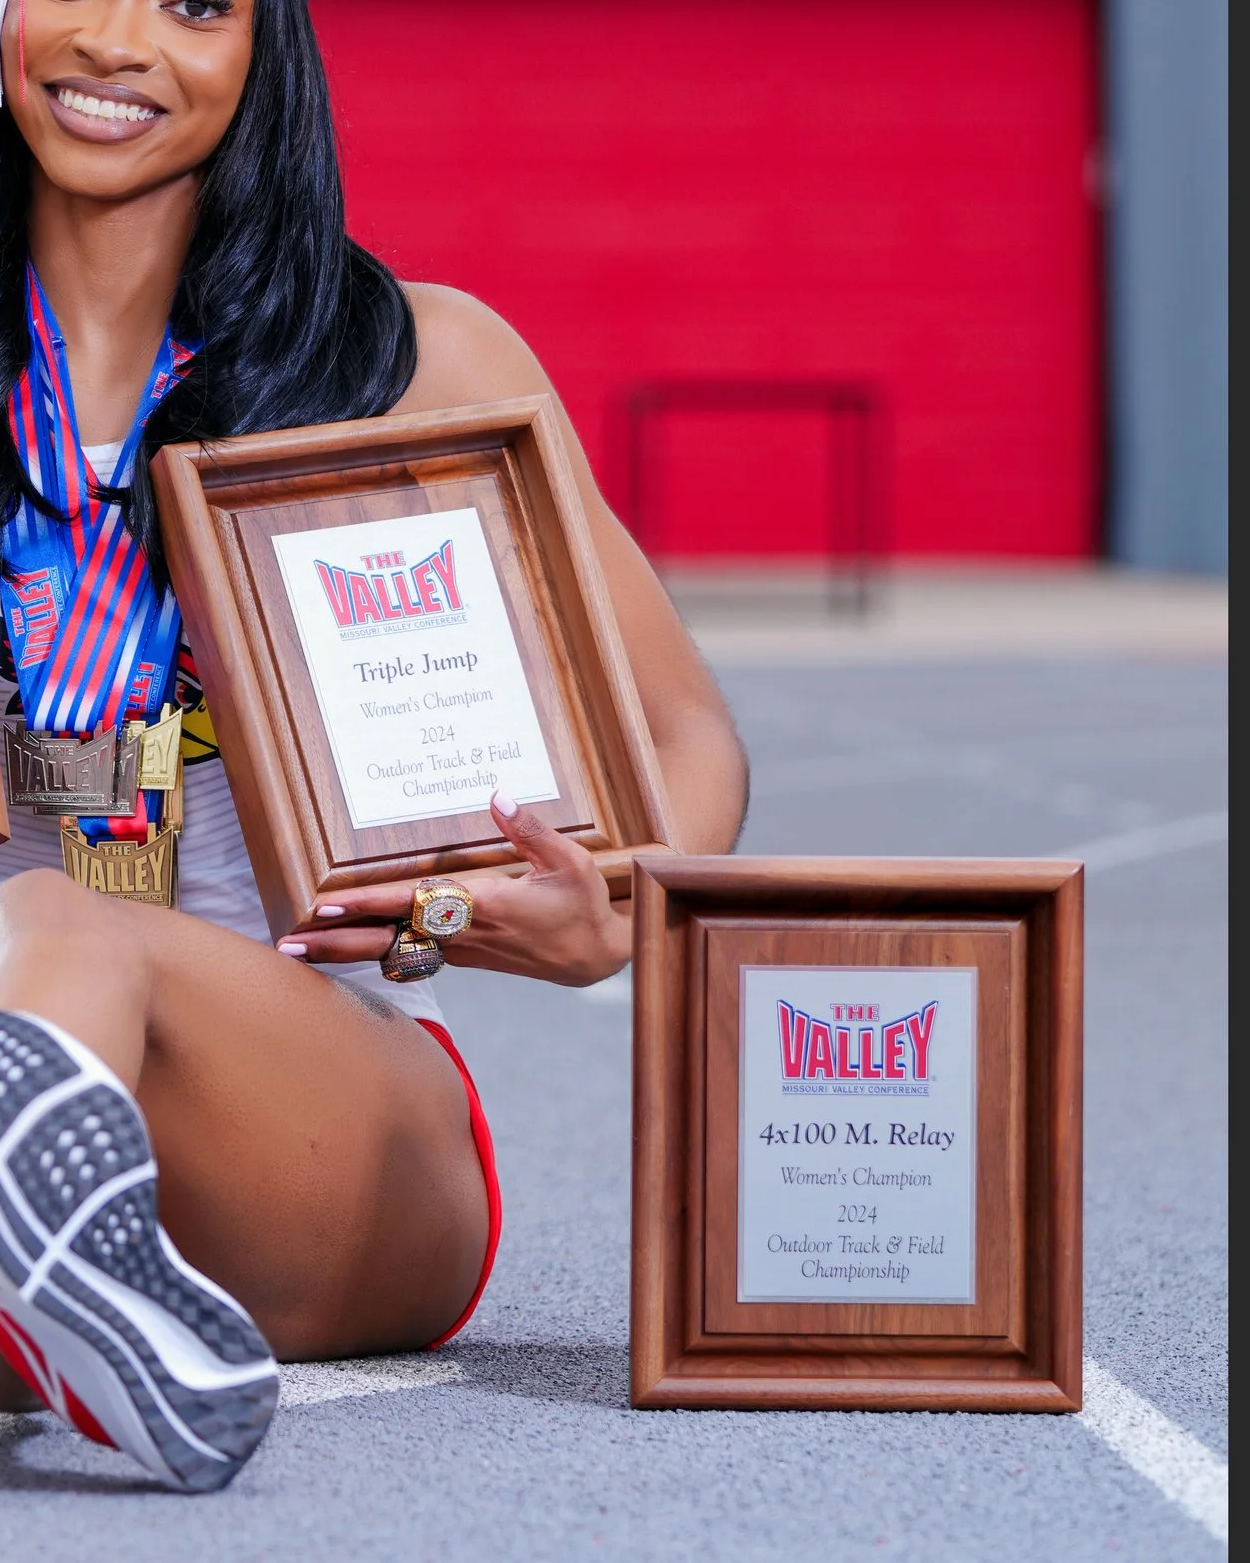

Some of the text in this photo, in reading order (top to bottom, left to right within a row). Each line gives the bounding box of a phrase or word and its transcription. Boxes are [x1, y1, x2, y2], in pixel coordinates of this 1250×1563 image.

[151, 371, 170, 399] THE
[360, 550, 407, 571] THE
[313, 539, 464, 629] VALLEY
[1, 567, 59, 670] VALLEY
[11, 607, 25, 637] THE
[340, 614, 468, 639] MISSOURI VALLEY CONFERENCE
[353, 651, 478, 684] Triple Jump
[360, 688, 494, 719] Women's Champion
[420, 725, 455, 745] 2024
[45, 745, 74, 756] THE
[367, 741, 522, 781] Outdoor Track & Field
[14, 744, 109, 793] VALLEY
[402, 769, 499, 798] Championship
[103, 846, 131, 856] THE
[70, 843, 166, 892] VALLEY
[830, 1003, 880, 1021] THE
[777, 999, 939, 1081] VALLEY
[782, 1084, 929, 1095] MISSOURI VALLEY CONFERENCE
[759, 1122, 955, 1151] 4x100 M. Relay
[780, 1166, 933, 1190] Women's Champion
[837, 1204, 878, 1224] 2024
[767, 1233, 945, 1255] Outdoor Track & Field
[801, 1259, 910, 1284] Championship
